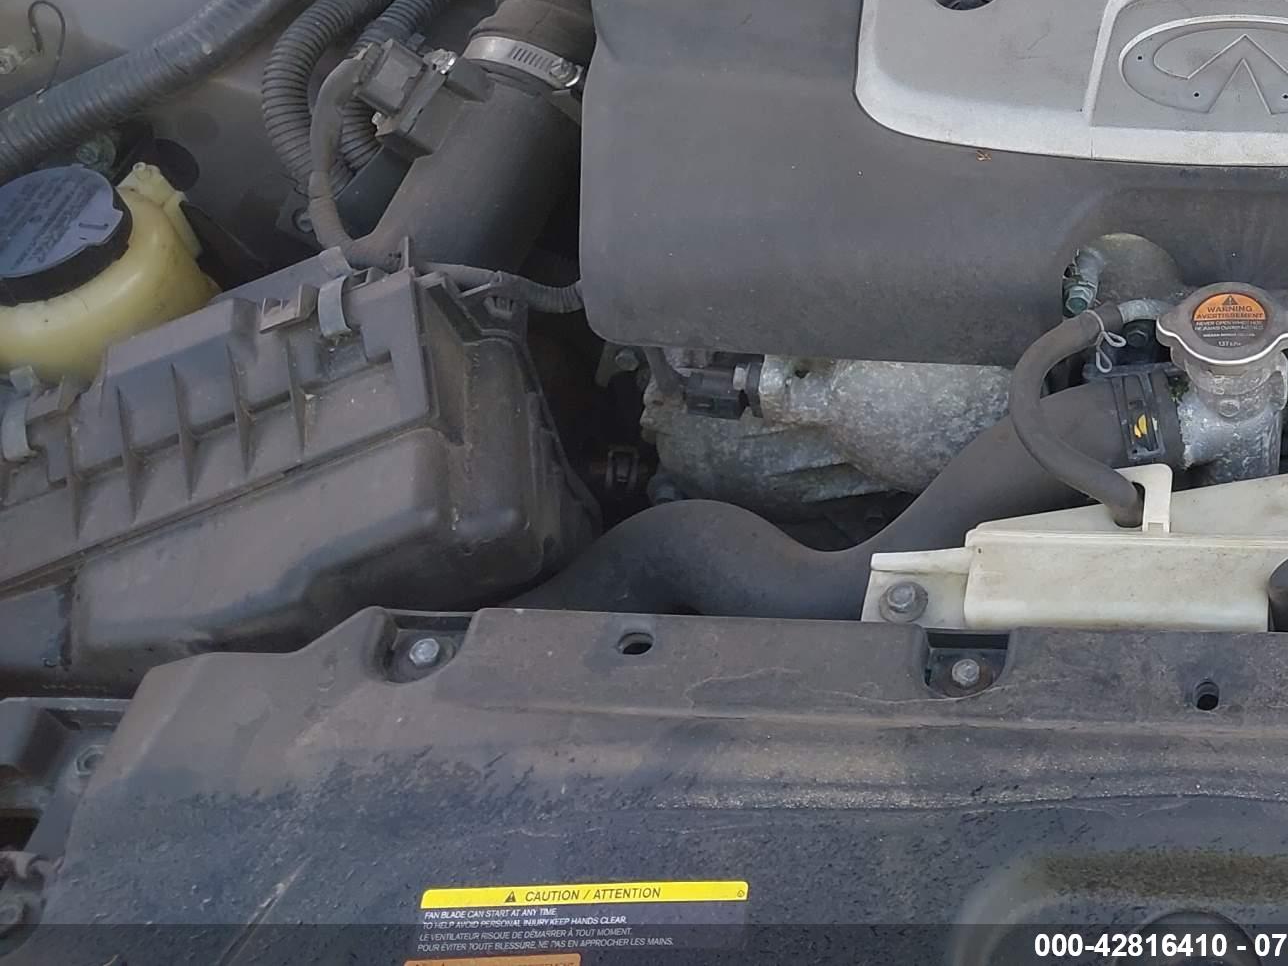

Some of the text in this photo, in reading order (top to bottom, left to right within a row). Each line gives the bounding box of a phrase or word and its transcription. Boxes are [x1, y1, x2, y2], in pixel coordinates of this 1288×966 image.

[525, 887, 661, 902] CAUTION / ATTENTION
[424, 911, 439, 919] FAN
[441, 910, 466, 919] BLADE
[467, 910, 484, 918] CAN
[486, 909, 509, 917] START
[510, 908, 521, 916] AT
[521, 908, 537, 916] ANY
[423, 921, 433, 929] TO
[434, 921, 454, 929] HELP
[455, 920, 479, 928] AVOID
[480, 919, 521, 928] PERSONAL
[549, 917, 570, 926] KEEP
[571, 916, 598, 925] HANDS
[419, 933, 430, 941] LE
[431, 931, 480, 941] VENTILATEUR
[481, 931, 510, 940] RISQUE
[511, 930, 524, 939] DE
[524, 928, 567, 938] DÉMARRER
[575, 927, 595, 937] TOUT
[417, 944, 440, 952] POUR
[441, 942, 466, 951] ÉVITER
[468, 942, 493, 951] TOUTE
[537, 940, 550, 949] NE
[567, 939, 579, 948] EN
[579, 938, 629, 947] APPROCHER
[630, 937, 646, 946] LES
